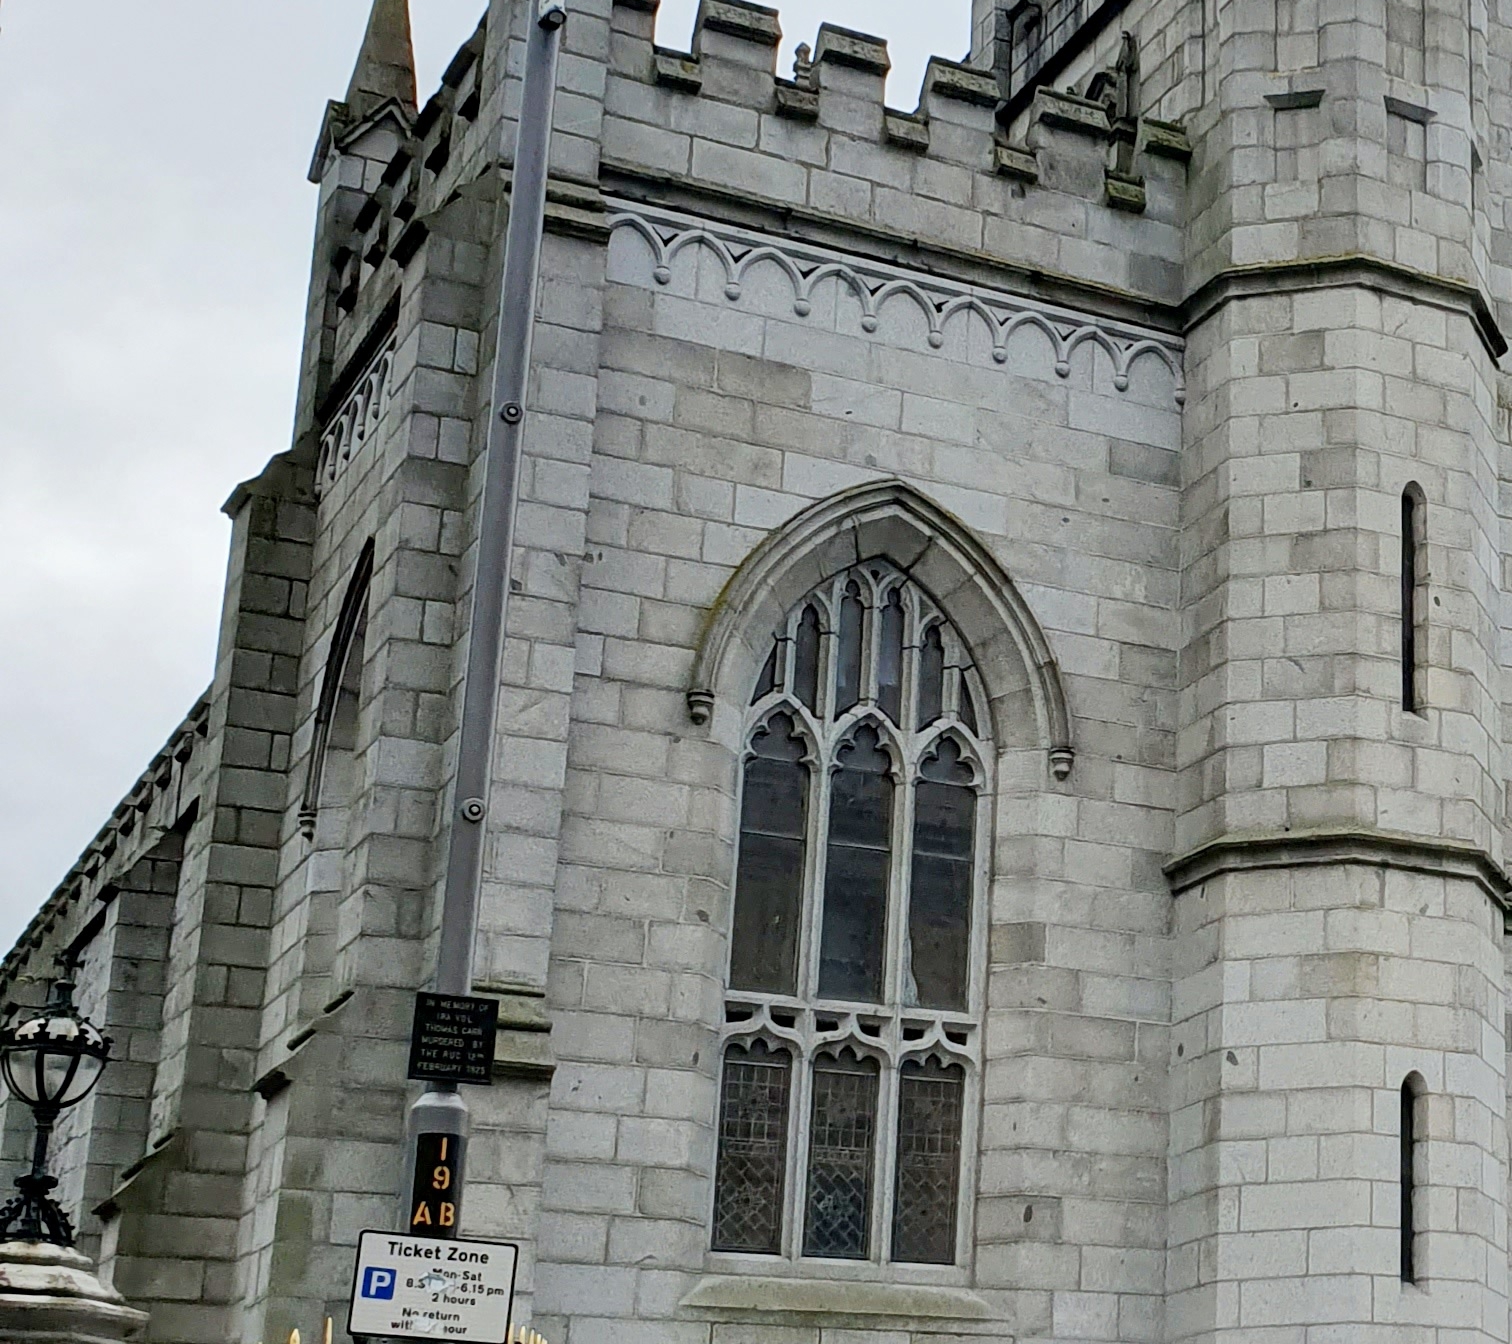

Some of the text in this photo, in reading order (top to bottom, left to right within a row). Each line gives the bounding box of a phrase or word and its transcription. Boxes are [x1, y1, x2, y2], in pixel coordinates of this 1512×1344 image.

[440, 1000, 475, 1011] MEMORY
[425, 1023, 458, 1034] THOMAS
[421, 1036, 484, 1049] MURDERED BY
[421, 1048, 439, 1059] THE
[416, 1061, 462, 1073] FEBRUARY
[432, 1165, 451, 1190] 9
[388, 1241, 490, 1265] Ticket Zone
[486, 1287, 505, 1297] pm
[431, 1292, 477, 1307] 2 hours
[422, 1309, 461, 1322] return
